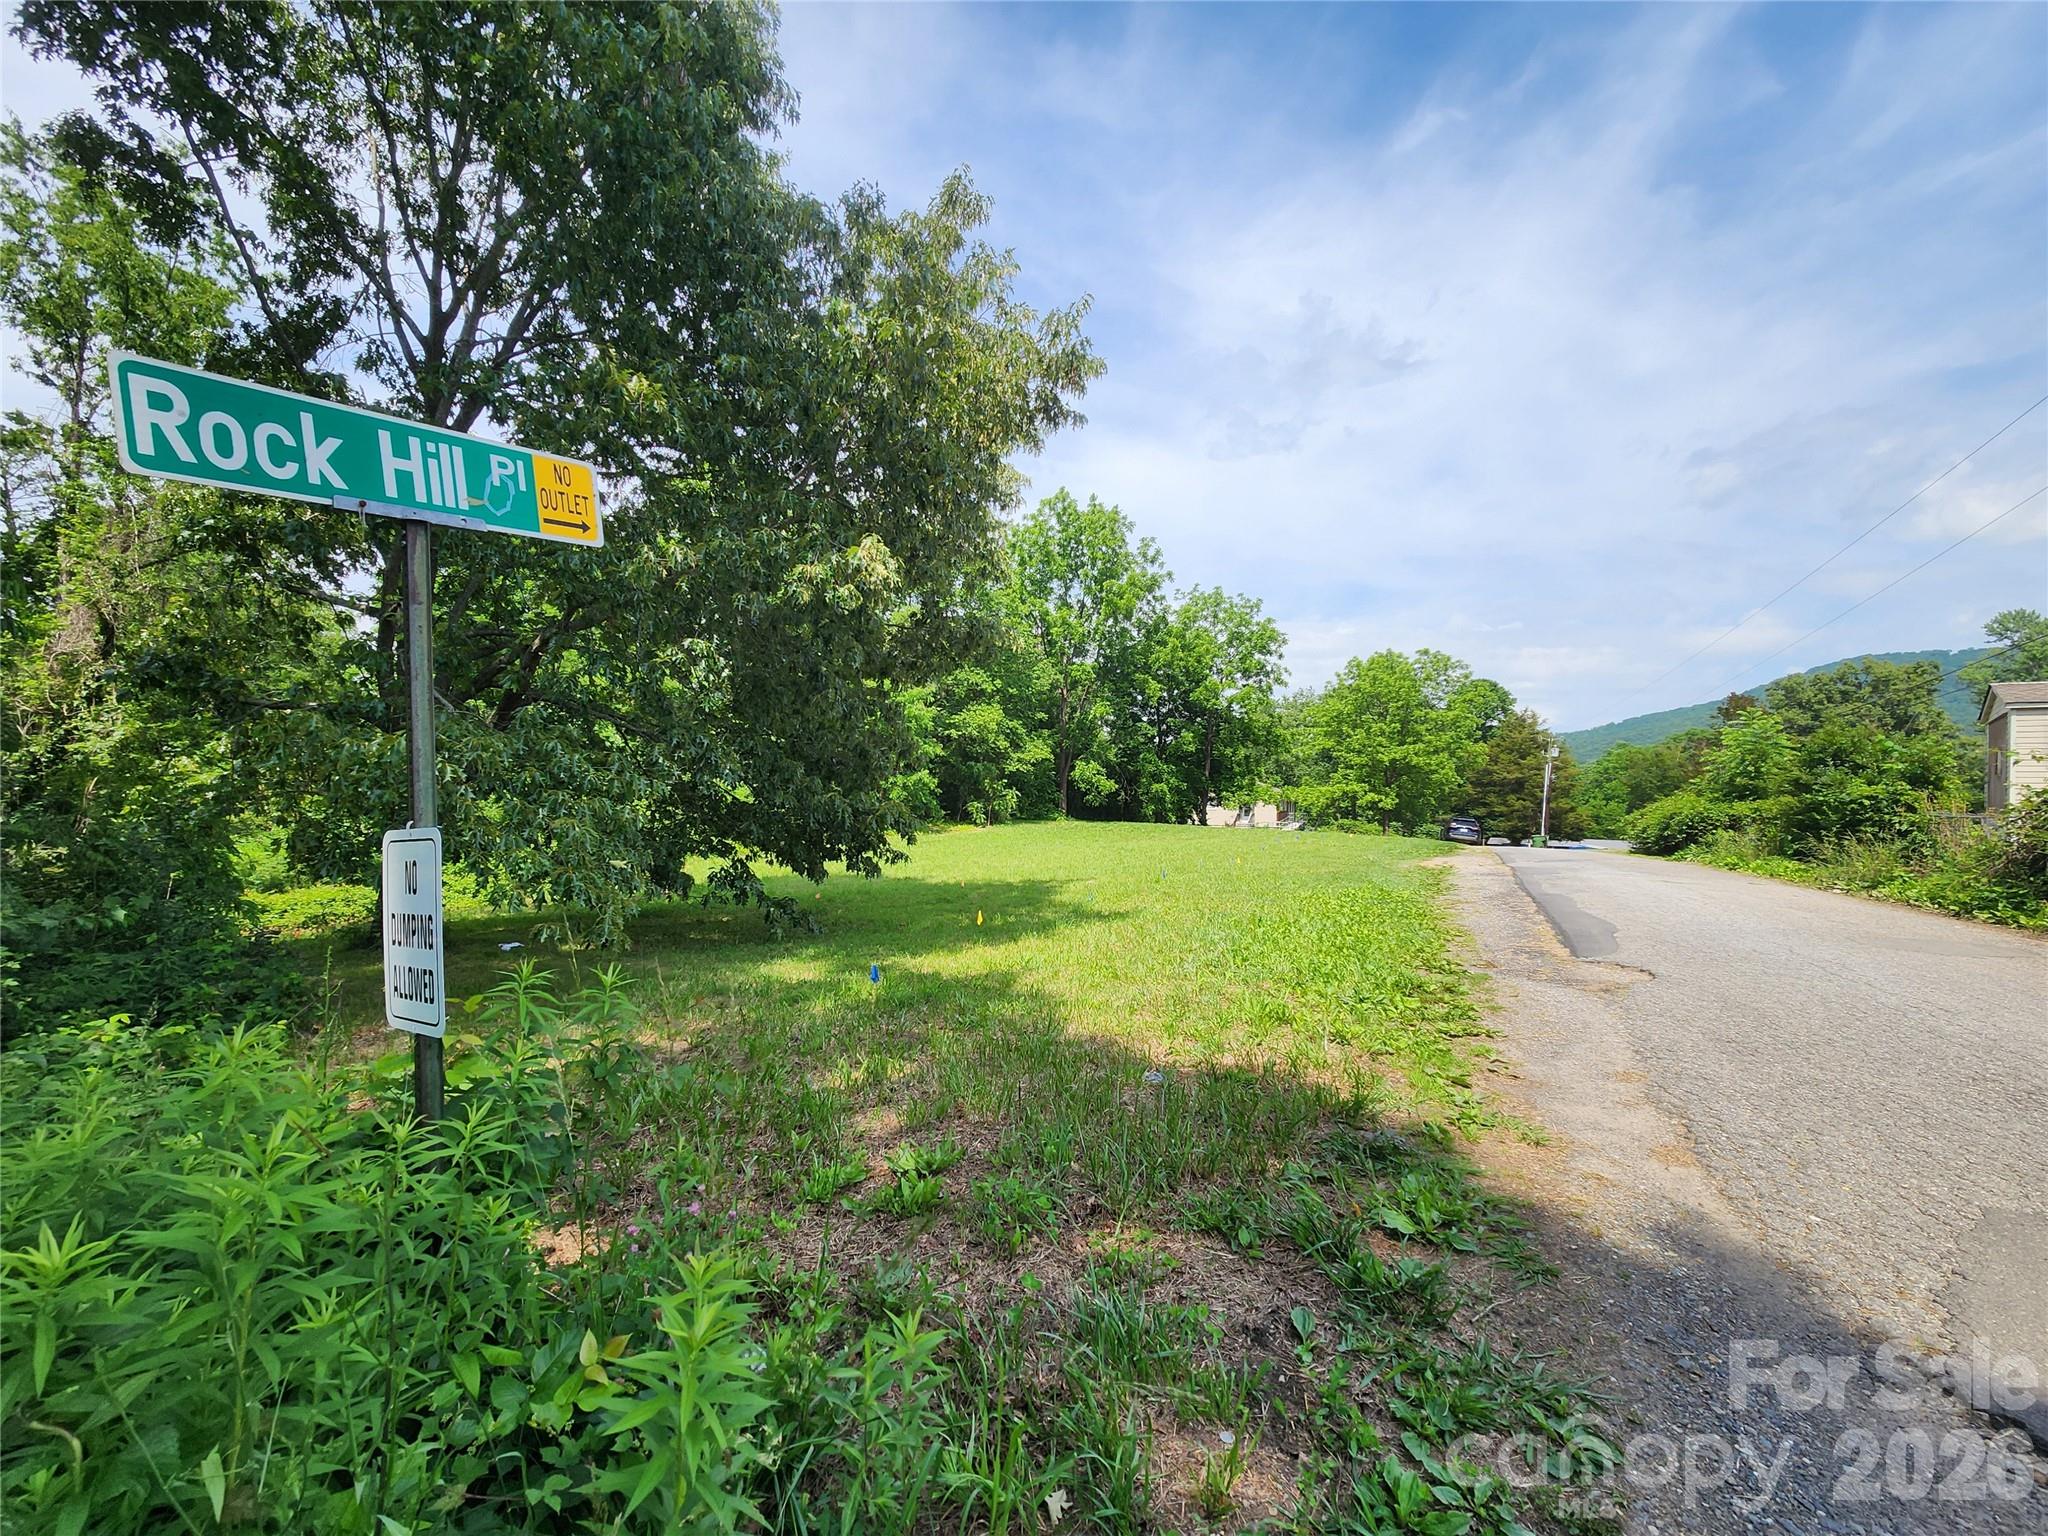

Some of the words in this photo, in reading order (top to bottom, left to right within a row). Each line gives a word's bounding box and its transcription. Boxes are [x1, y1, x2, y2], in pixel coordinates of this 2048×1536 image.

[127, 372, 348, 489] Rock
[378, 430, 469, 511] Hill
[490, 454, 527, 491] Pl
[553, 464, 572, 487] NO
[540, 488, 588, 516] OUTLET
[404, 860, 417, 895] NO
[391, 912, 433, 951] DUMPING
[393, 965, 435, 1004] ALLOWED
